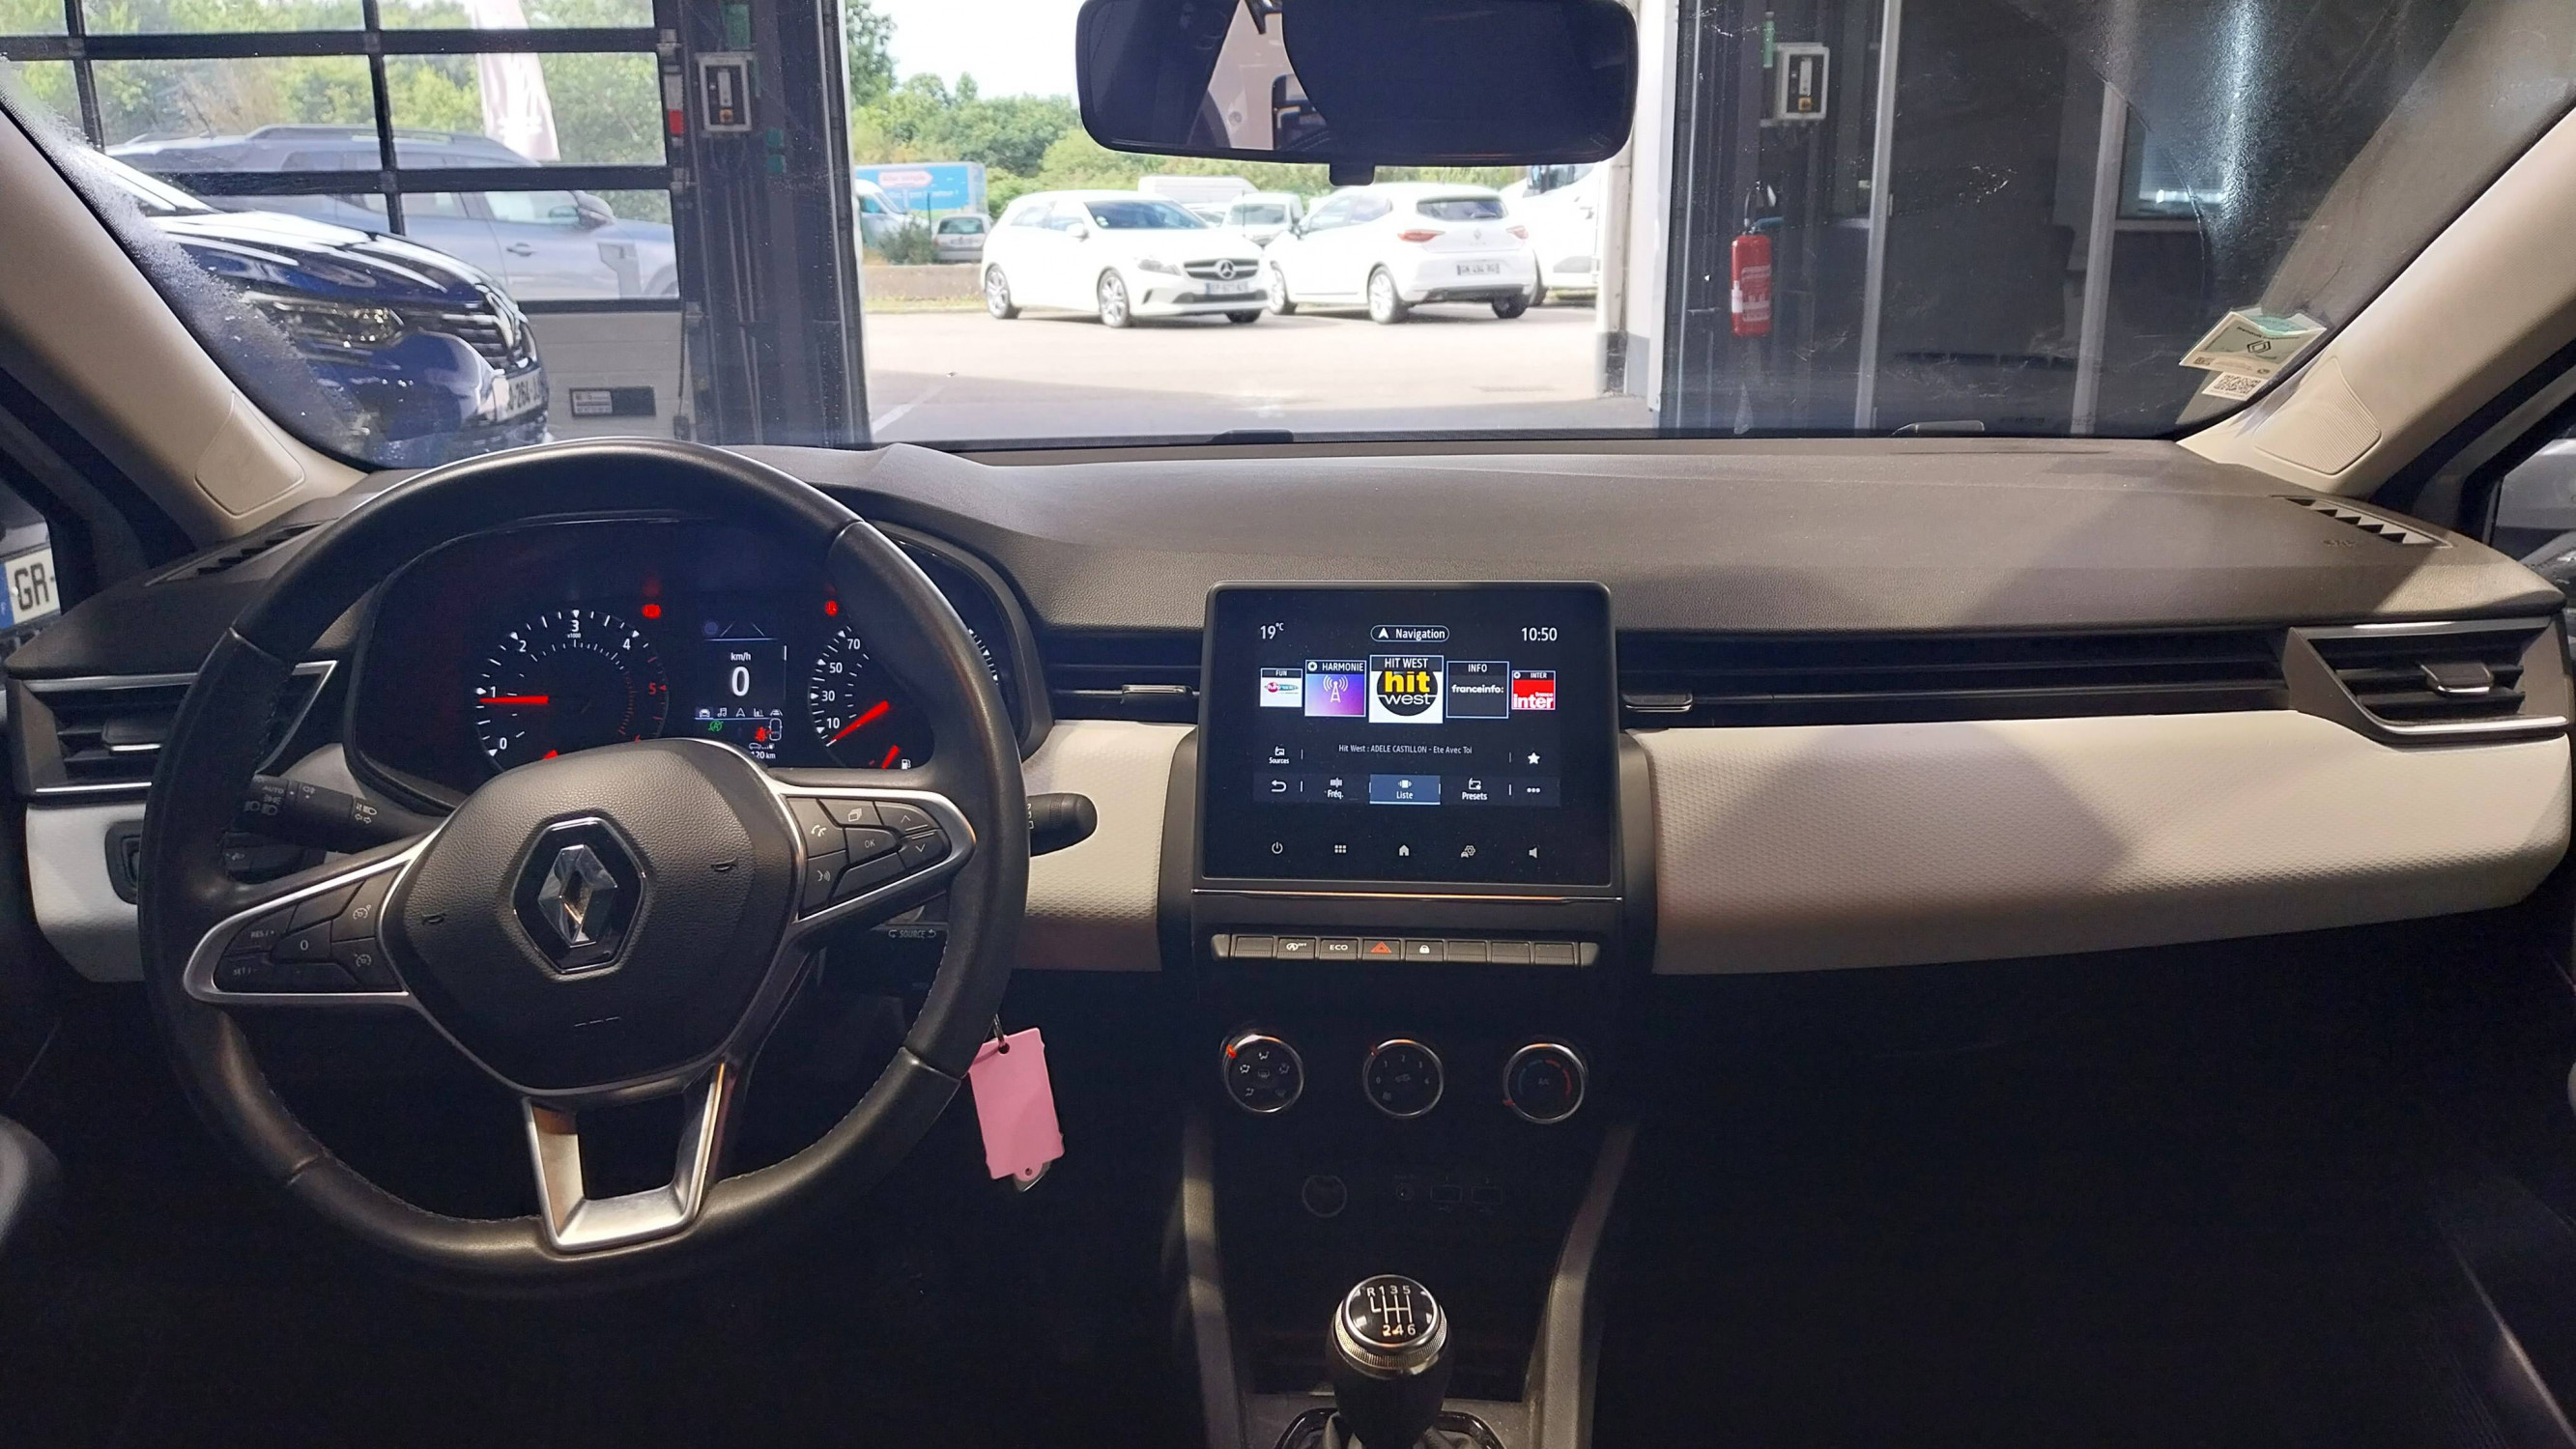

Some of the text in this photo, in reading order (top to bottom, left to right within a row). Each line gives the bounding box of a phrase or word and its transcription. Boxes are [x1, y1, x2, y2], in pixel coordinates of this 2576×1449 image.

[571, 619, 580, 632] 3
[1395, 628, 1445, 641] Navigation
[1521, 627, 1558, 641] 10:50
[519, 640, 528, 652] 2
[622, 639, 631, 650] 4
[846, 638, 861, 650] 70
[730, 652, 752, 662] km/h
[829, 662, 844, 673] 50
[1322, 663, 1363, 671] HARMONIE
[1385, 658, 1428, 668] HIT WEST
[1468, 664, 1488, 672] INFO
[731, 666, 750, 696] 0
[1385, 671, 1430, 693] hit
[490, 686, 497, 697] 1
[648, 683, 657, 695] 5
[1451, 684, 1504, 694] franceinfo:
[821, 690, 836, 701] 30
[1384, 694, 1431, 705] west
[1513, 693, 1554, 708] inter
[826, 718, 841, 728] 10
[499, 737, 507, 749] 0
[1392, 745, 1427, 753] CASTILLON
[864, 838, 875, 848] OK
[899, 929, 926, 939] SOURCE
[300, 939, 309, 952] 0
[1366, 1285, 1411, 1297] R 1 3 5
[1383, 1323, 1417, 1337] 2 4 6
